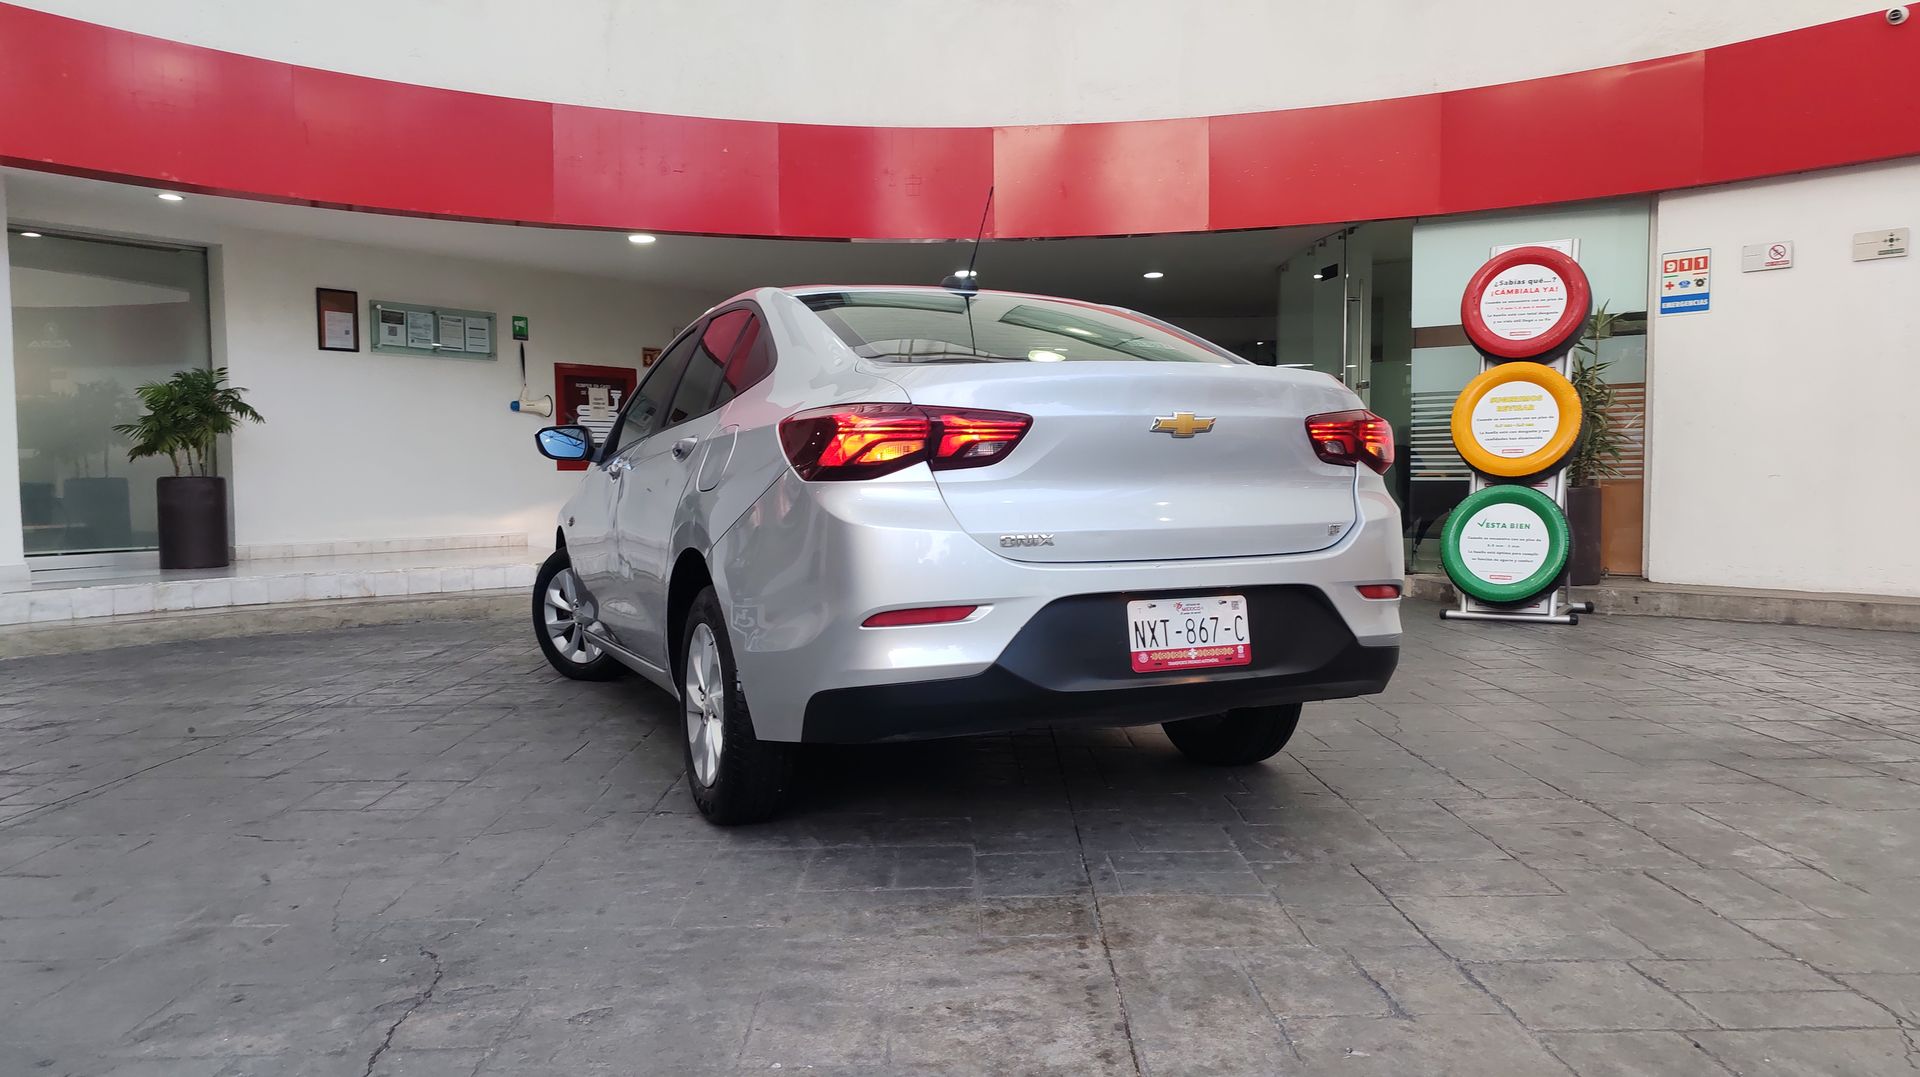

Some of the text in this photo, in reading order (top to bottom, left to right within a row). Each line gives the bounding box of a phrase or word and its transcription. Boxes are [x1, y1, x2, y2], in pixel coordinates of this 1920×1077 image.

[1665, 257, 1706, 272] 911
[1000, 533, 1055, 547] ONIX
[1134, 615, 1245, 648] NXT-867-C
